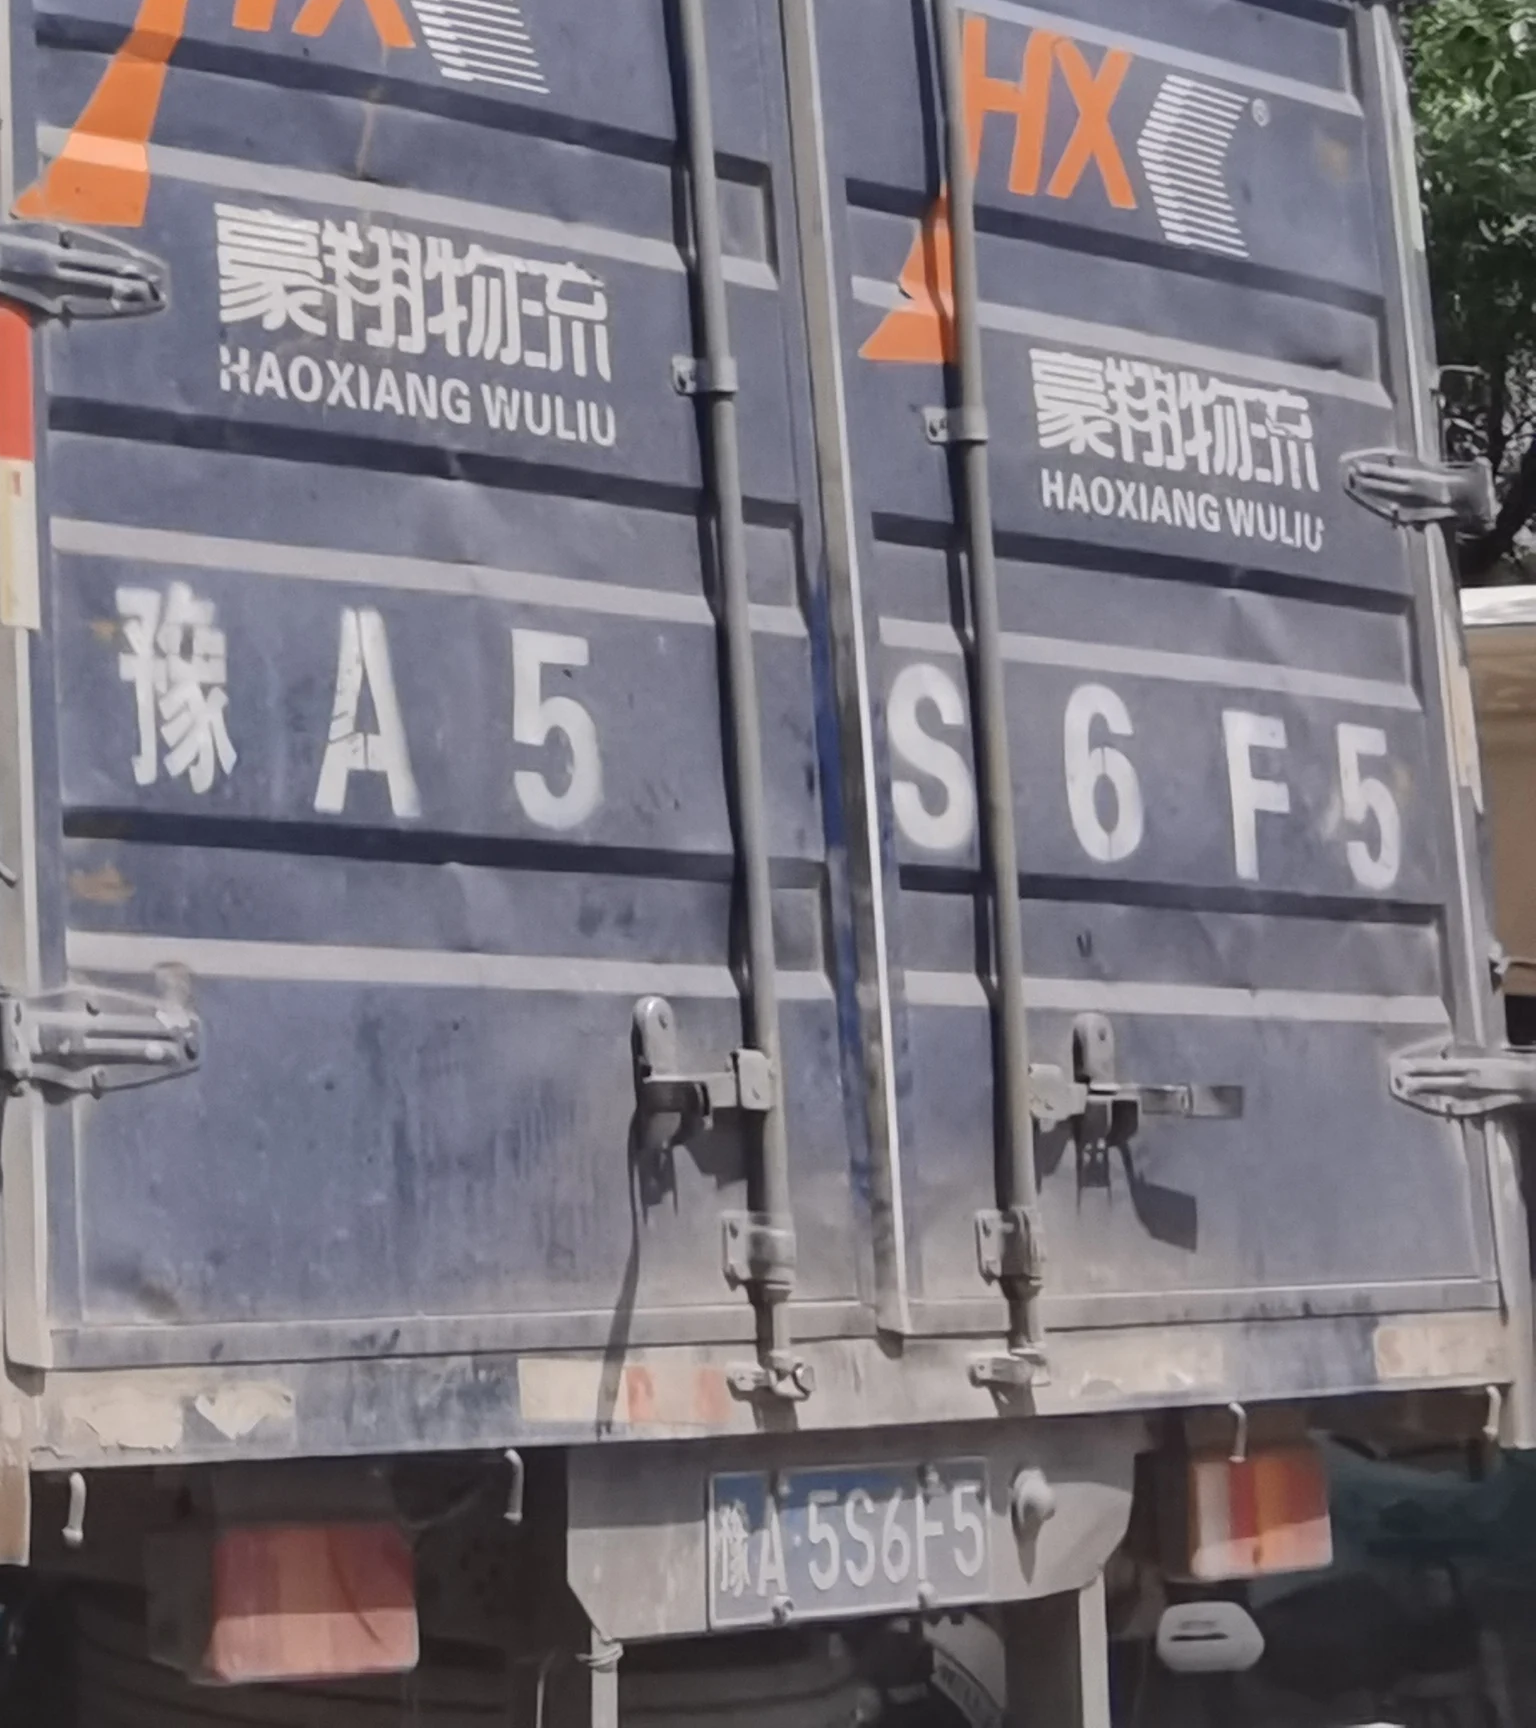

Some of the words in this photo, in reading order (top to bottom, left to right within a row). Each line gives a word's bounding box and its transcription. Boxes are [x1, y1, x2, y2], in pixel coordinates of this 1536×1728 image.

[214, 202, 611, 381] 豪翔物流
[219, 346, 472, 424] HAOXIANG
[481, 382, 617, 448] WULIU
[1030, 347, 1319, 492] 豪翔物流
[1041, 468, 1223, 534] HAOXIANG
[1226, 497, 1324, 553] WULIU
